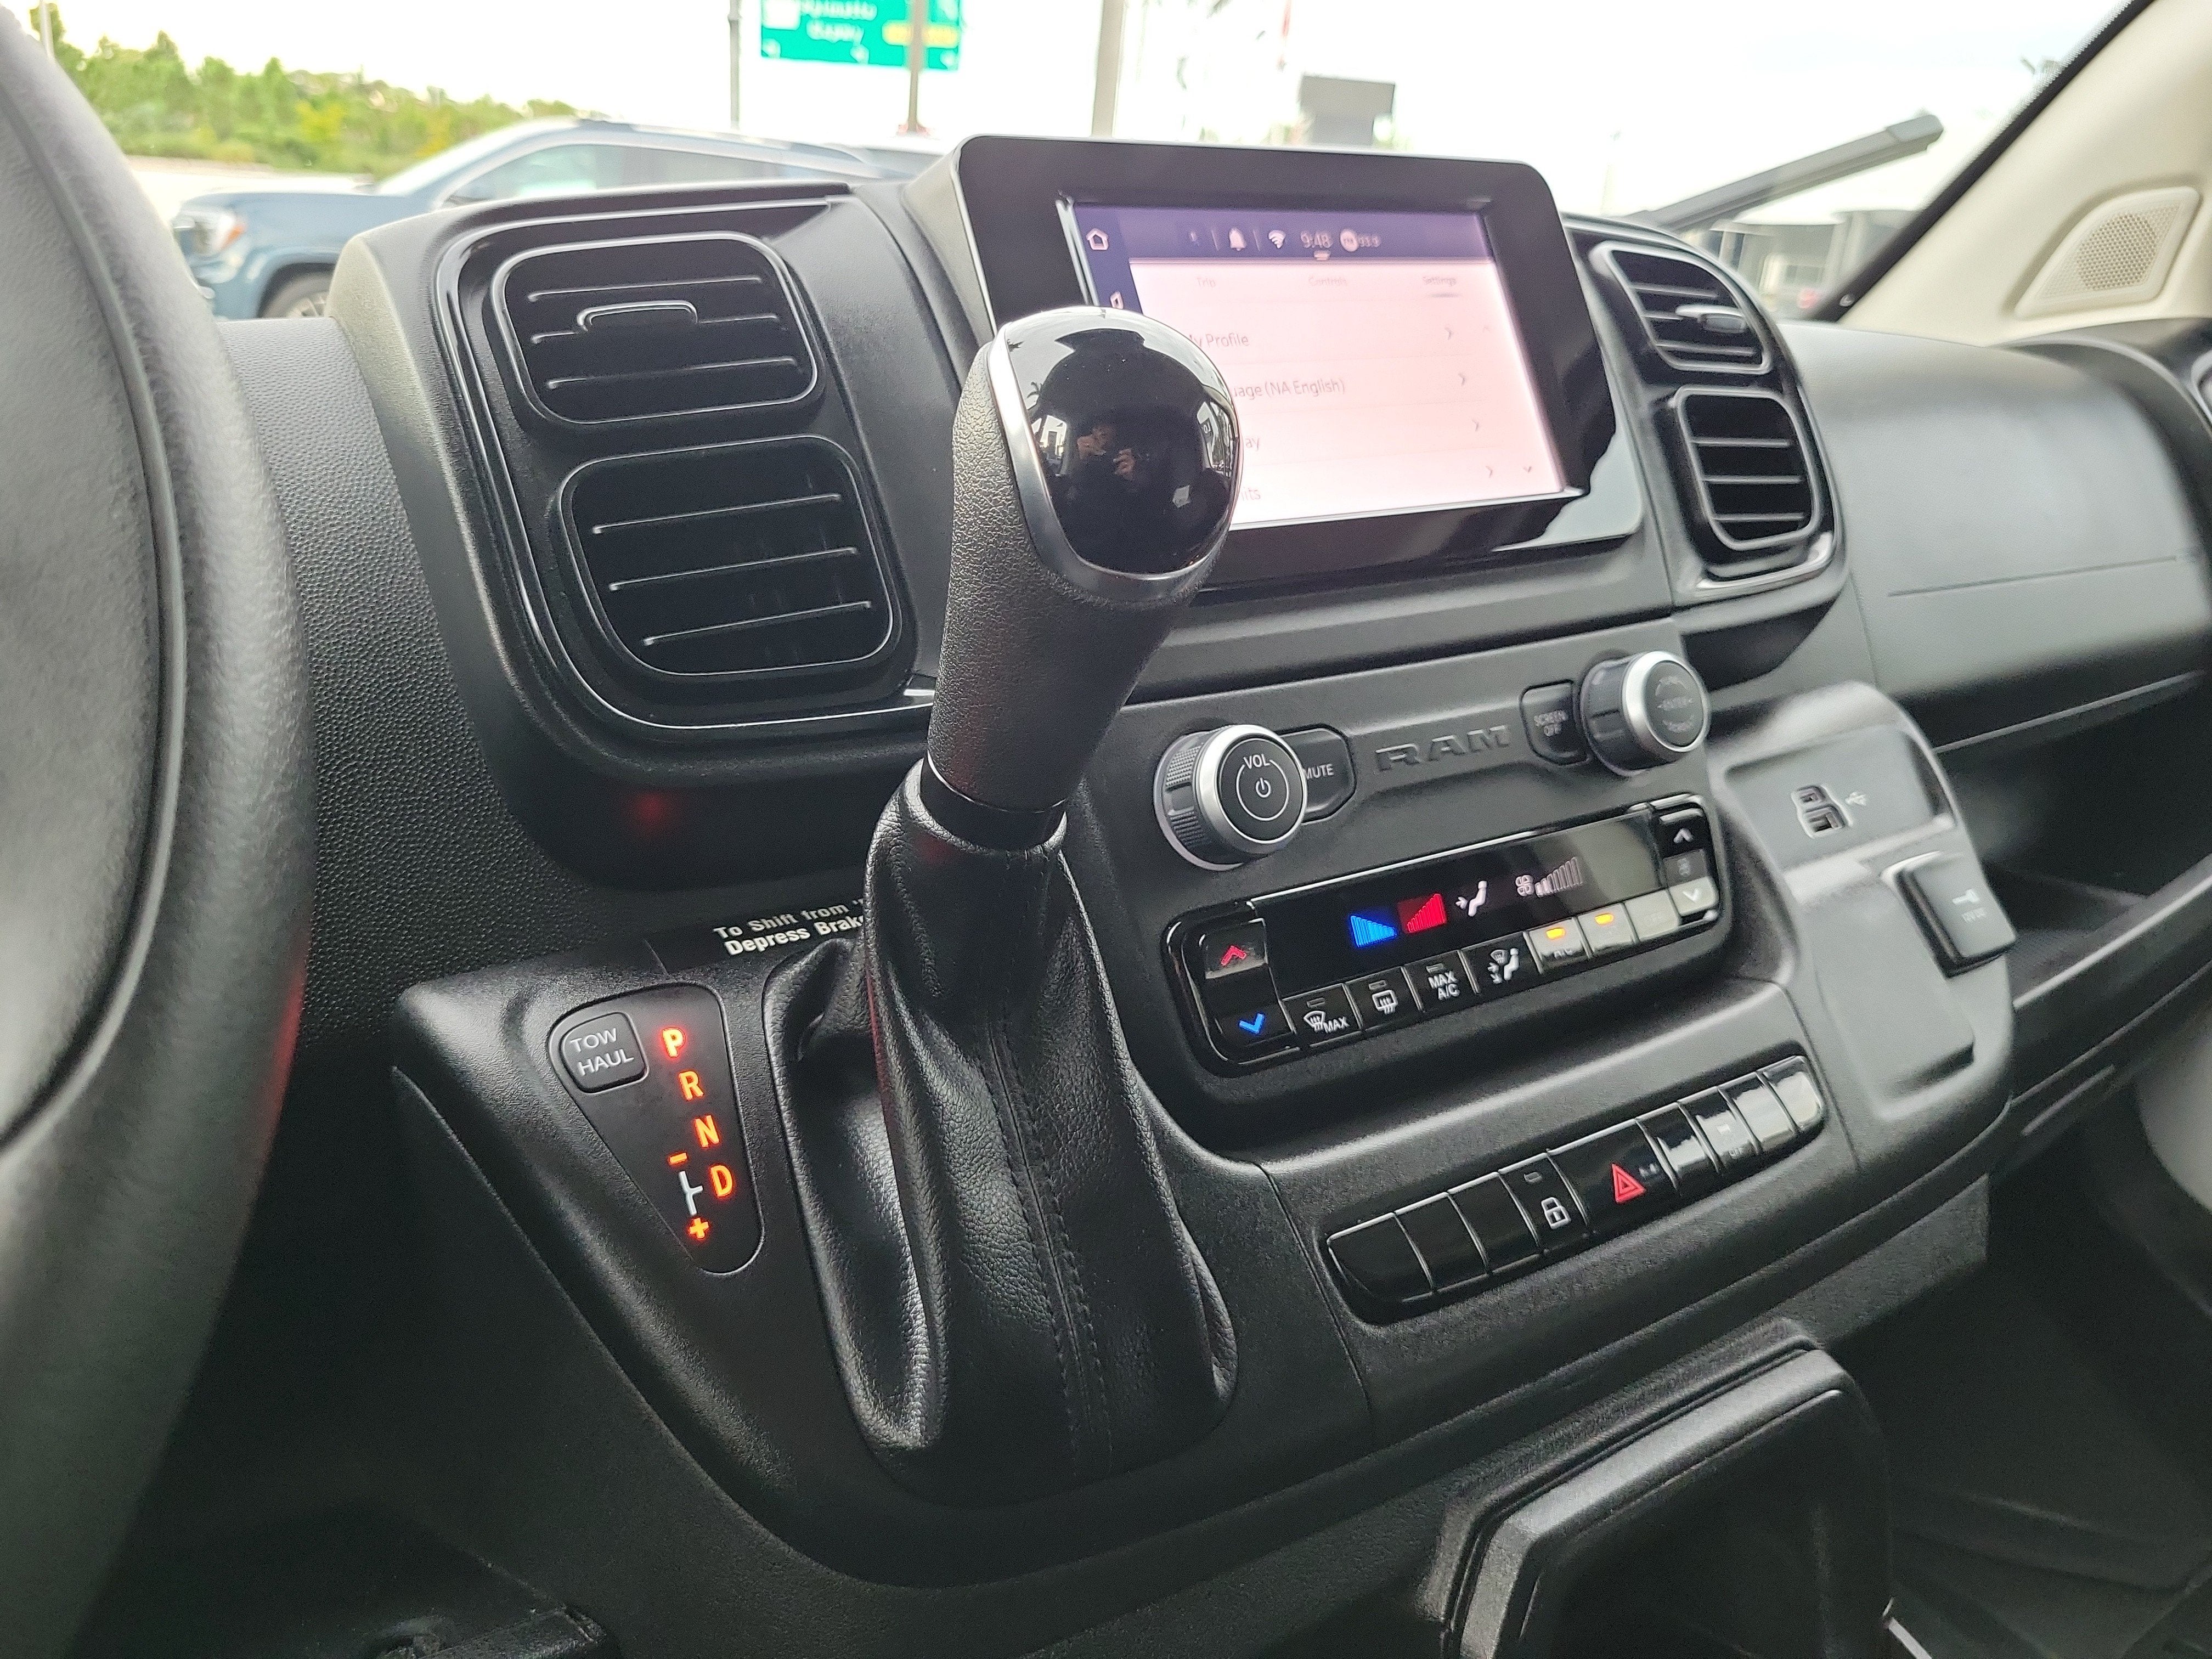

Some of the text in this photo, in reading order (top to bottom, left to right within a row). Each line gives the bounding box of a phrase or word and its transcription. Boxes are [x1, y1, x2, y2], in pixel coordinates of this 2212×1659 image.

[1301, 230, 1332, 248] 9:48
[1198, 277, 1216, 288] Trip
[1423, 276, 1457, 287] Settings
[1206, 332, 1250, 348] Profile
[1265, 381, 1290, 397] (NA
[1293, 378, 1345, 397] English)
[1375, 725, 1512, 772] RAM
[1243, 754, 1271, 769] VOL
[1302, 764, 1334, 780] MUTE
[713, 905, 849, 939] To Shift from
[725, 927, 811, 956] Depress
[1429, 971, 1458, 989] MAX
[1437, 984, 1460, 1001] A/C
[1324, 1015, 1350, 1033] MAX
[571, 1028, 617, 1052] TOW
[662, 1028, 685, 1058] P
[578, 1048, 634, 1076] HAUL
[679, 1070, 704, 1100] R
[694, 1114, 720, 1148] N
[710, 1165, 733, 1197] D
